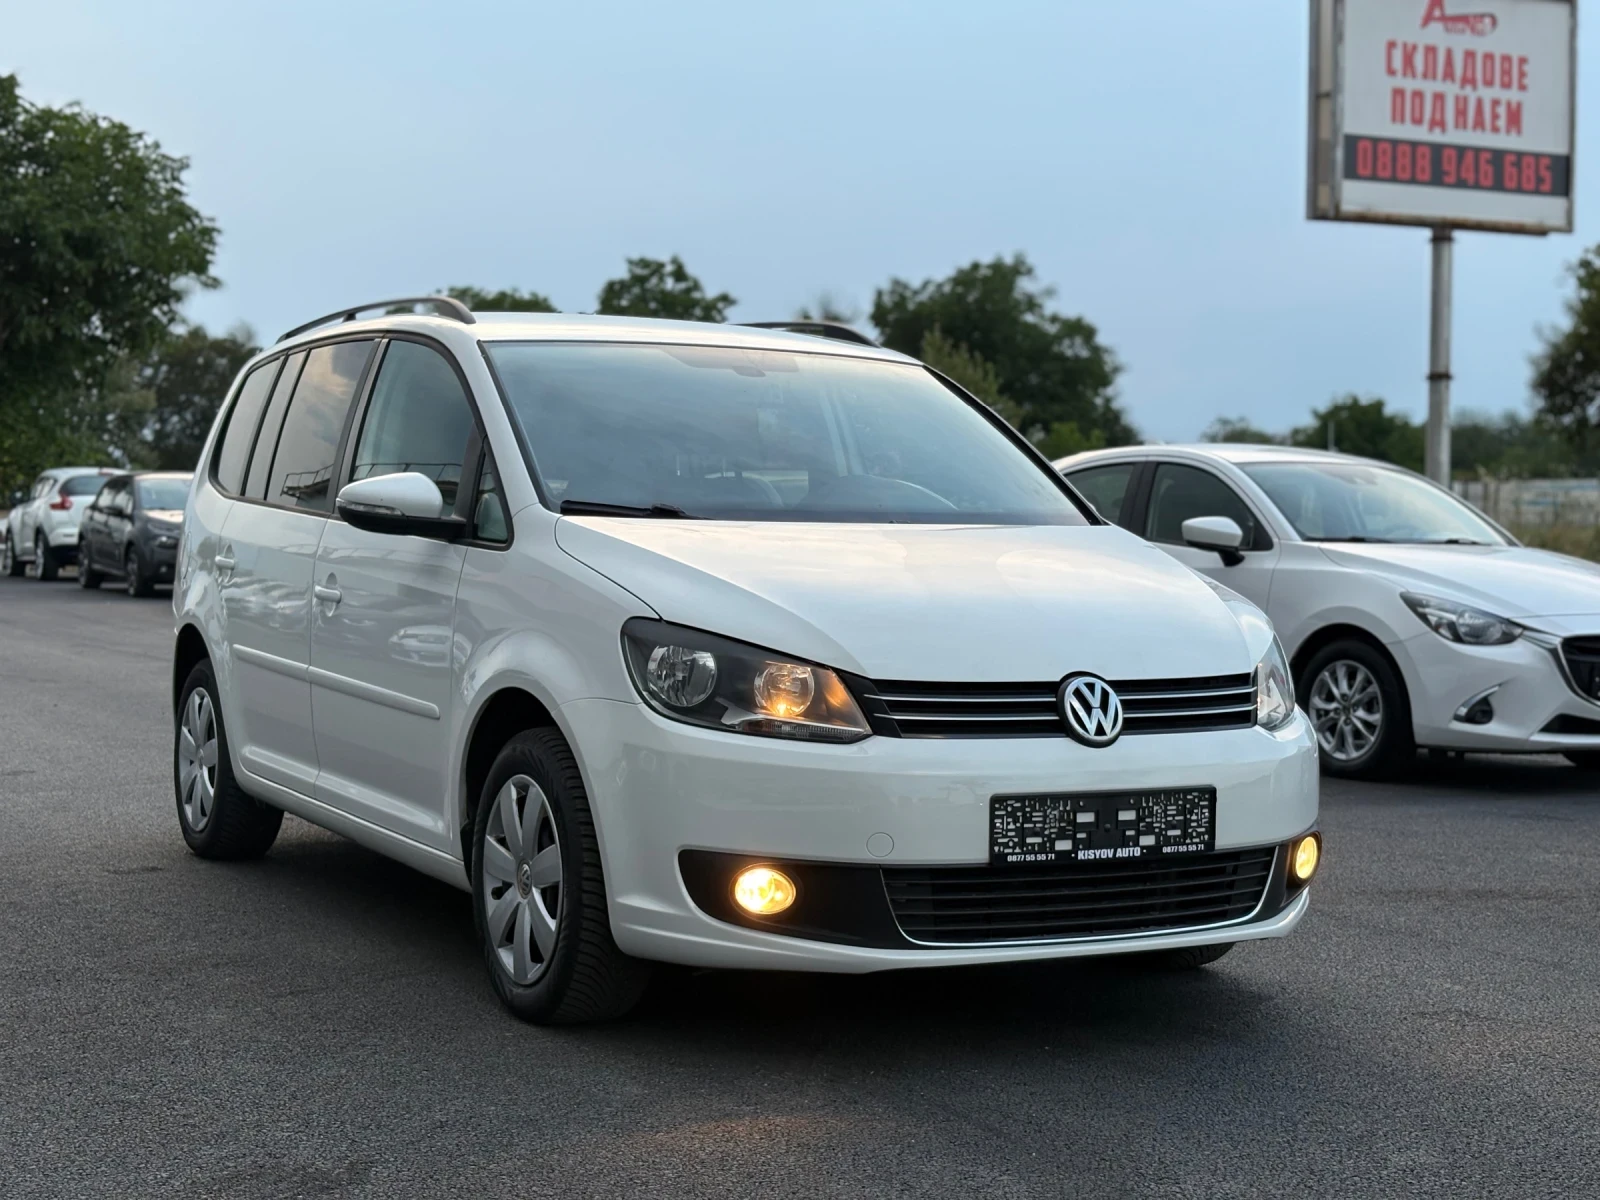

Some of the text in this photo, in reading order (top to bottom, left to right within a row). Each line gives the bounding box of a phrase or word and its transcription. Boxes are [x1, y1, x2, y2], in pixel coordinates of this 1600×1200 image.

[1385, 39, 1529, 92] СКЛАДОВЕ
[1356, 138, 1553, 193] 0888 946 685
[1077, 846, 1141, 860] KISYOV AUTO
[1162, 845, 1178, 853] 0877
[1197, 843, 1205, 851] 71
[1007, 854, 1025, 862] 0877
[1036, 853, 1047, 861] 55
